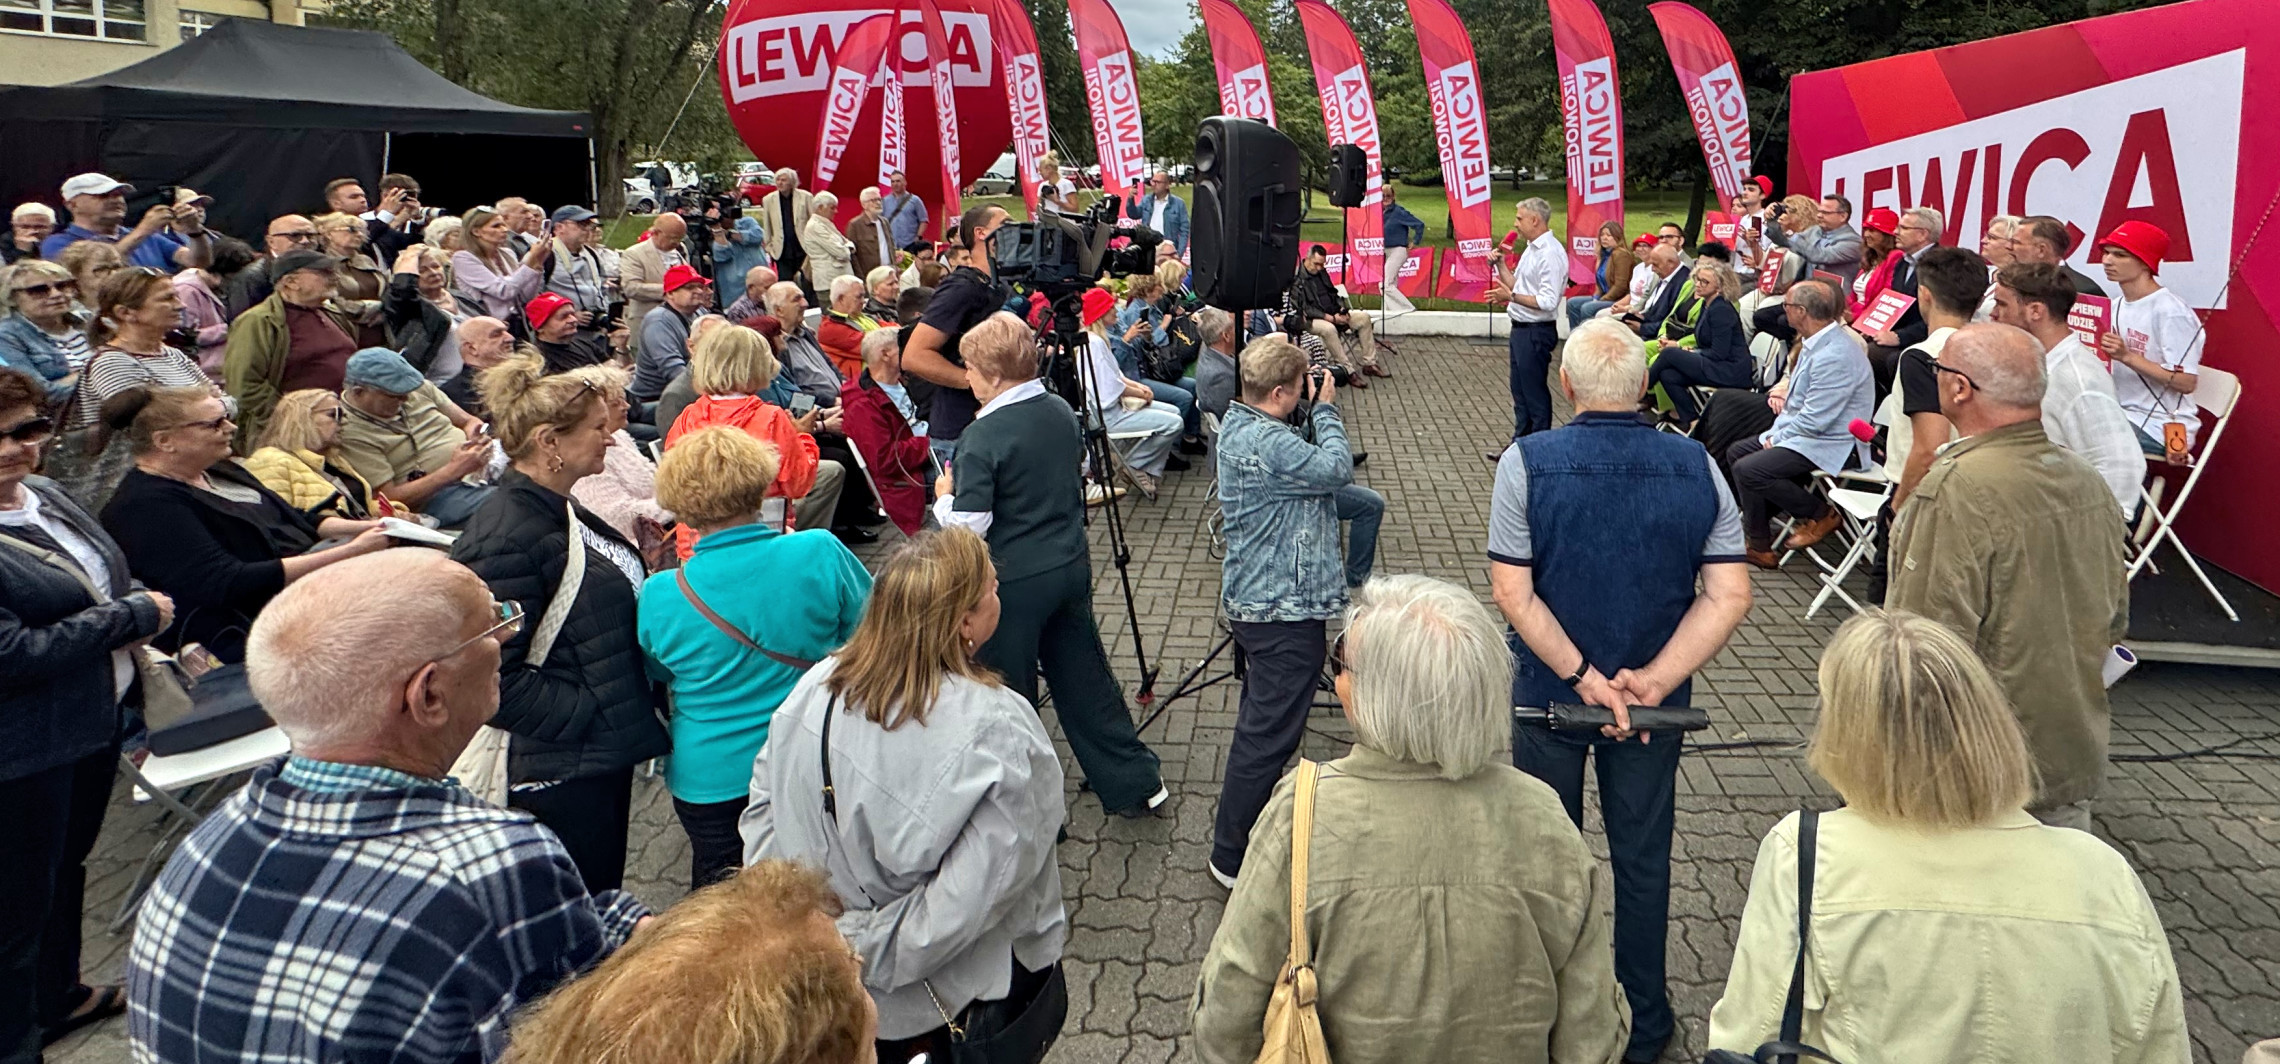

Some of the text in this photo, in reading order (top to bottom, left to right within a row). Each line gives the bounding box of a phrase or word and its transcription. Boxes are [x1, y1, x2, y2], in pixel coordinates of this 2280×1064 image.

[736, 22, 982, 88] LEWCA
[821, 78, 861, 175] LEWICA
[1836, 107, 2194, 264] EWICA
[2067, 314, 2098, 332] UDZIE,
[2070, 302, 2104, 318] PIERW
